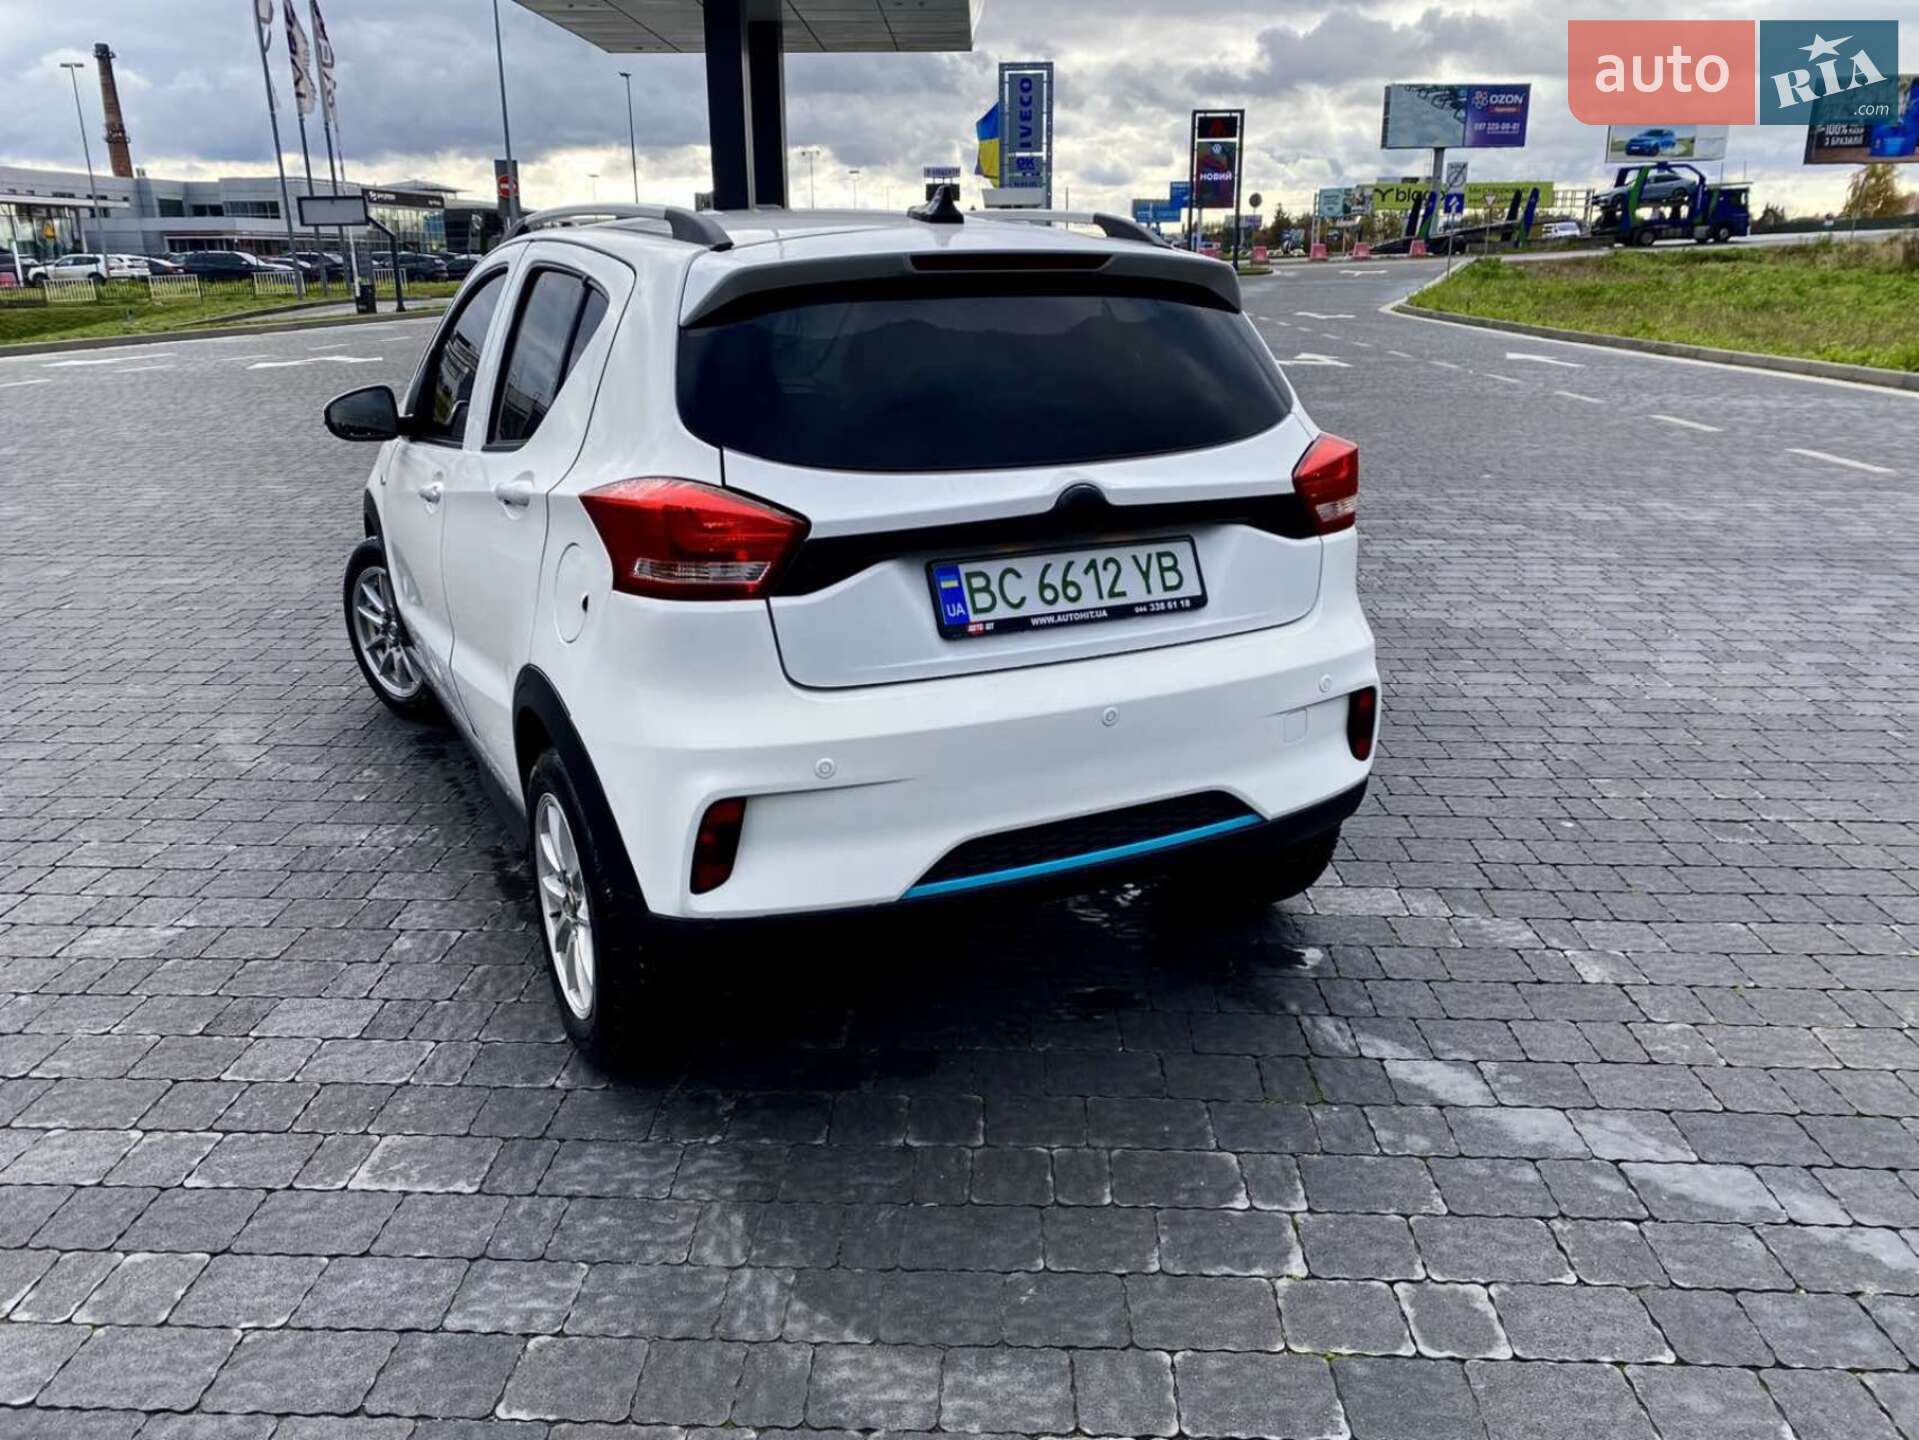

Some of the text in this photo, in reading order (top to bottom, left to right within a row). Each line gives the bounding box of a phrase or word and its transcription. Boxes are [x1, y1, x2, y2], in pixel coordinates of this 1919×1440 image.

[1489, 94, 1523, 105] OZON
[1019, 77, 1033, 149] IVECO
[1200, 171, 1232, 181] НОВИЙ
[965, 550, 1184, 615] BC 6612 YB
[947, 603, 966, 618] UA
[1030, 609, 1109, 627] WWW.AUTOHIT.UA
